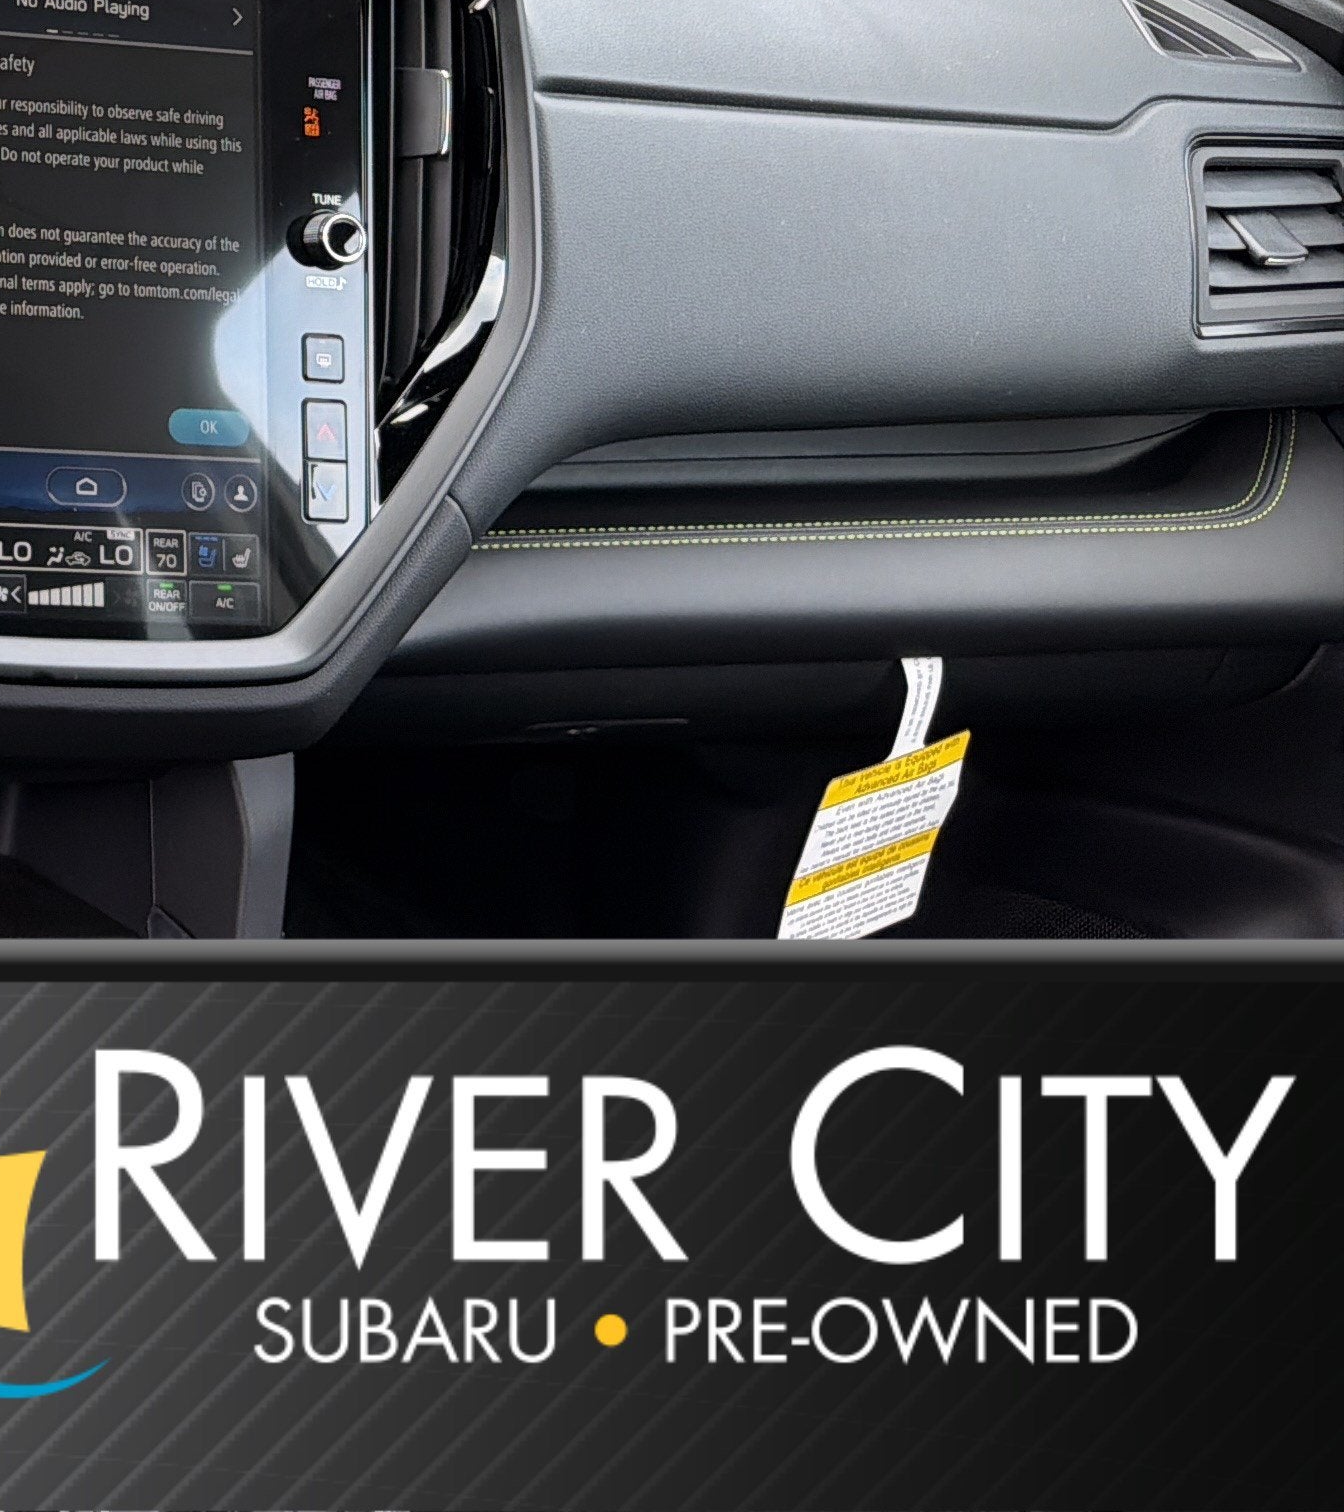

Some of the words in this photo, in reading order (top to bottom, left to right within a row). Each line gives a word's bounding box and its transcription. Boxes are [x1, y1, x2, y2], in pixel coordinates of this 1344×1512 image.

[308, 77, 342, 90] PASSENGER
[11, 98, 89, 120] responsibility
[91, 104, 104, 117] to
[107, 104, 153, 122] observe
[156, 107, 181, 123] safe
[184, 109, 224, 130] driving
[12, 122, 35, 137] and
[38, 124, 53, 139] all
[56, 125, 117, 144] applicable
[120, 129, 147, 146] laws
[151, 132, 182, 149] while
[185, 134, 218, 154] using
[221, 137, 242, 153] this
[1, 146, 18, 161] Do
[21, 149, 41, 163] not
[45, 150, 90, 168] operate
[94, 155, 120, 171] your
[123, 155, 169, 173] product
[172, 157, 204, 175] while
[312, 192, 342, 206] TUNE
[8, 223, 37, 239] does
[40, 226, 60, 241] not
[64, 227, 125, 246] guarantee
[128, 231, 148, 246] the
[151, 234, 202, 254] accuracy
[205, 235, 218, 250] of
[221, 237, 240, 253] the
[29, 250, 82, 268] provided
[85, 256, 97, 269] or
[101, 255, 157, 272] error-free
[160, 259, 220, 277] operation.
[21, 275, 55, 292] terms
[59, 279, 96, 297] apply;
[98, 284, 114, 299] go
[118, 282, 130, 296] to
[133, 284, 240, 307] tomtom.com/legal
[11, 301, 84, 320] information.
[199, 420, 219, 435] OK
[74, 530, 93, 543] A/C
[153, 538, 179, 548] REAR
[99, 544, 133, 566] LO
[156, 554, 177, 569] 70
[153, 588, 181, 600] REAR
[148, 601, 186, 613] ON/OFF
[215, 597, 234, 610] A/C
